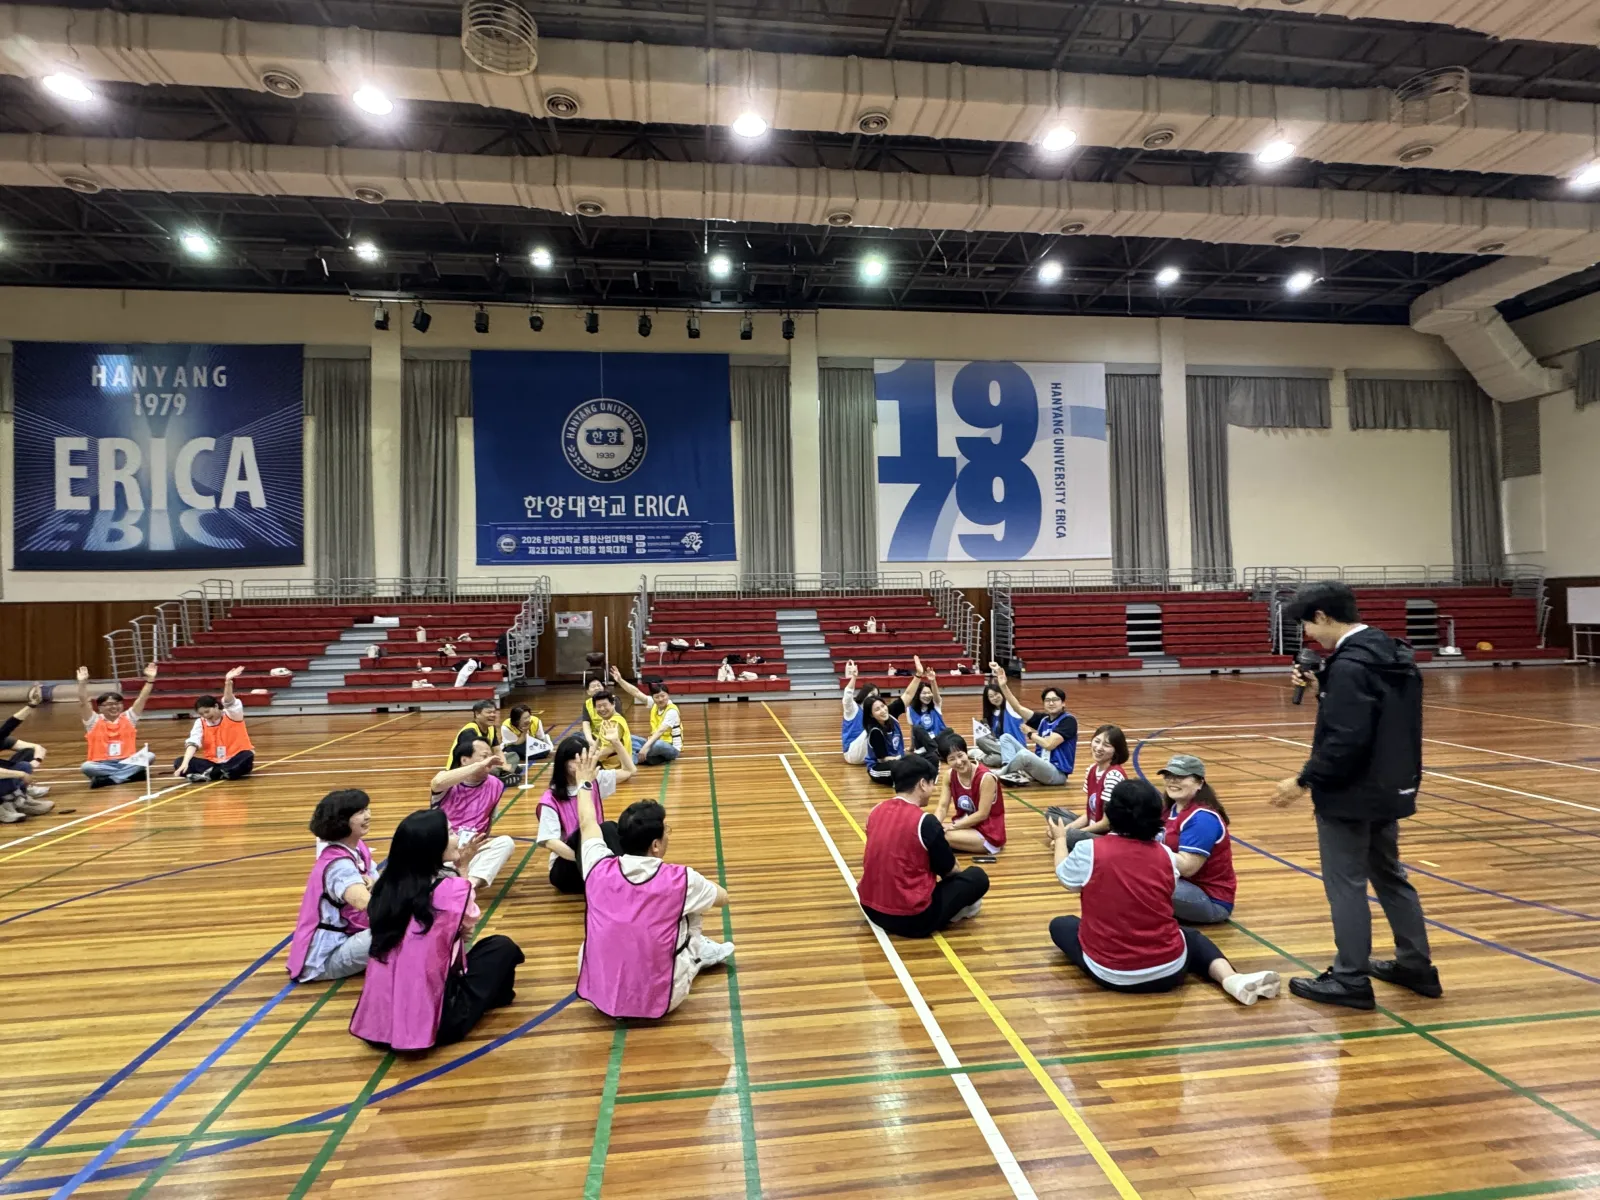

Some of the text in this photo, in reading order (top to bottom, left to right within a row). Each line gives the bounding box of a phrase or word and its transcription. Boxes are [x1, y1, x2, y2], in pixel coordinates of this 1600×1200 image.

[91, 365, 227, 387] HANYANG
[133, 393, 187, 416] 1979
[566, 402, 643, 439] HANYANG UNIVERSITY
[592, 431, 617, 444] 한양
[1051, 382, 1067, 539] HANYANG UNIVERSITY ERICA
[55, 437, 267, 510] ERICA
[523, 494, 690, 519] 한양대학교 ERICA
[521, 536, 542, 544] 2026
[543, 535, 581, 544] 한양대학교
